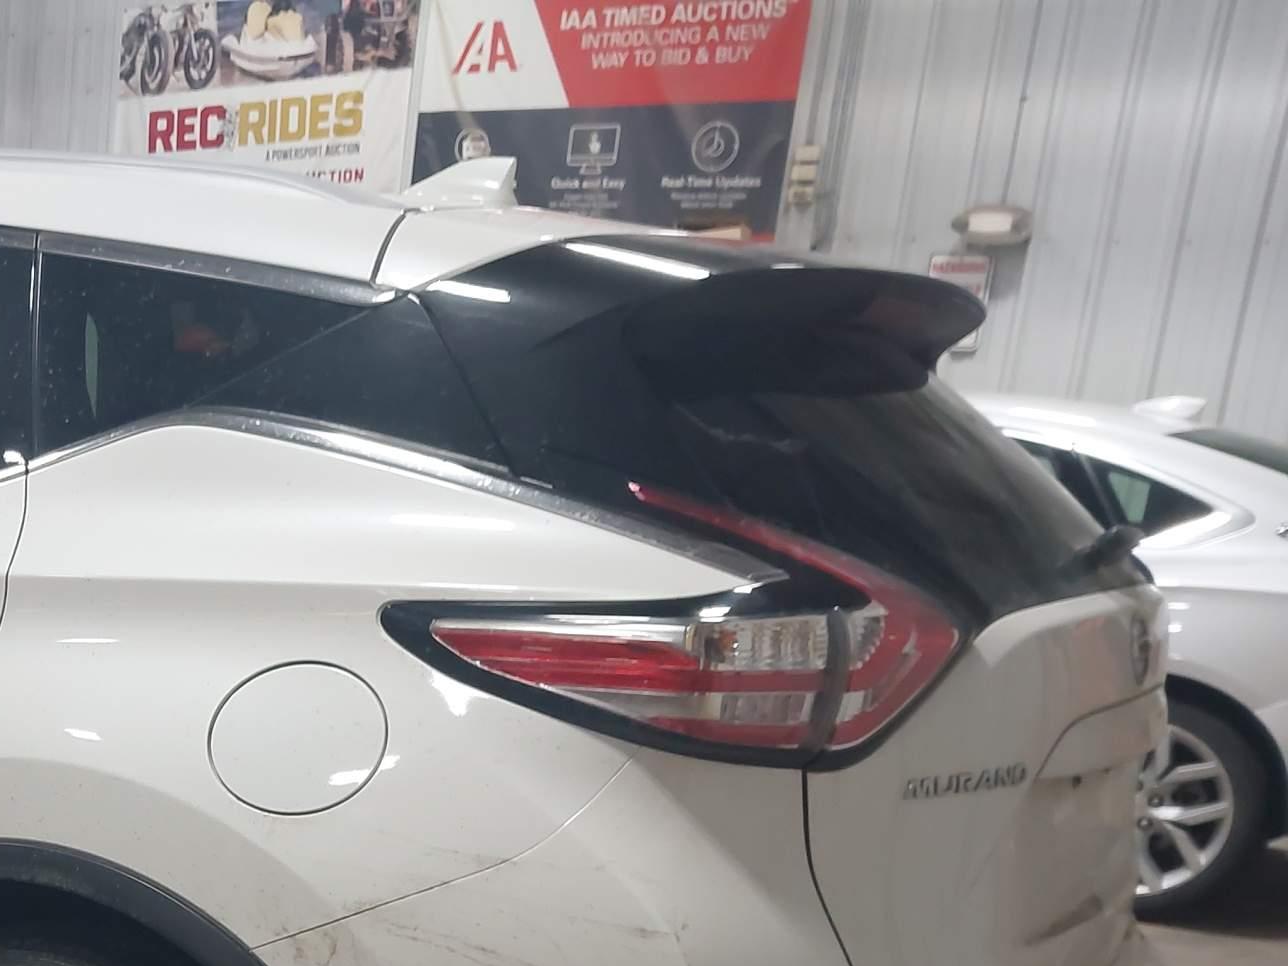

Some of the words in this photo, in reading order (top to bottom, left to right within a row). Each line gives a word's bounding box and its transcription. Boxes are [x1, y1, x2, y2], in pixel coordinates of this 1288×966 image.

[560, 8, 596, 31] IAA
[603, 6, 665, 28] TIMED
[670, 0, 787, 24] AUCTIONS
[581, 27, 701, 49] INTRODUCING
[706, 26, 720, 41] A
[725, 23, 772, 40] NEW
[591, 52, 627, 69] WAY
[634, 50, 658, 66] TO
[662, 48, 691, 65] BID
[695, 47, 709, 64] &
[715, 45, 755, 64] BUY
[148, 105, 226, 154] REC
[237, 91, 364, 146] RIDES
[903, 761, 1027, 800] MURANO
